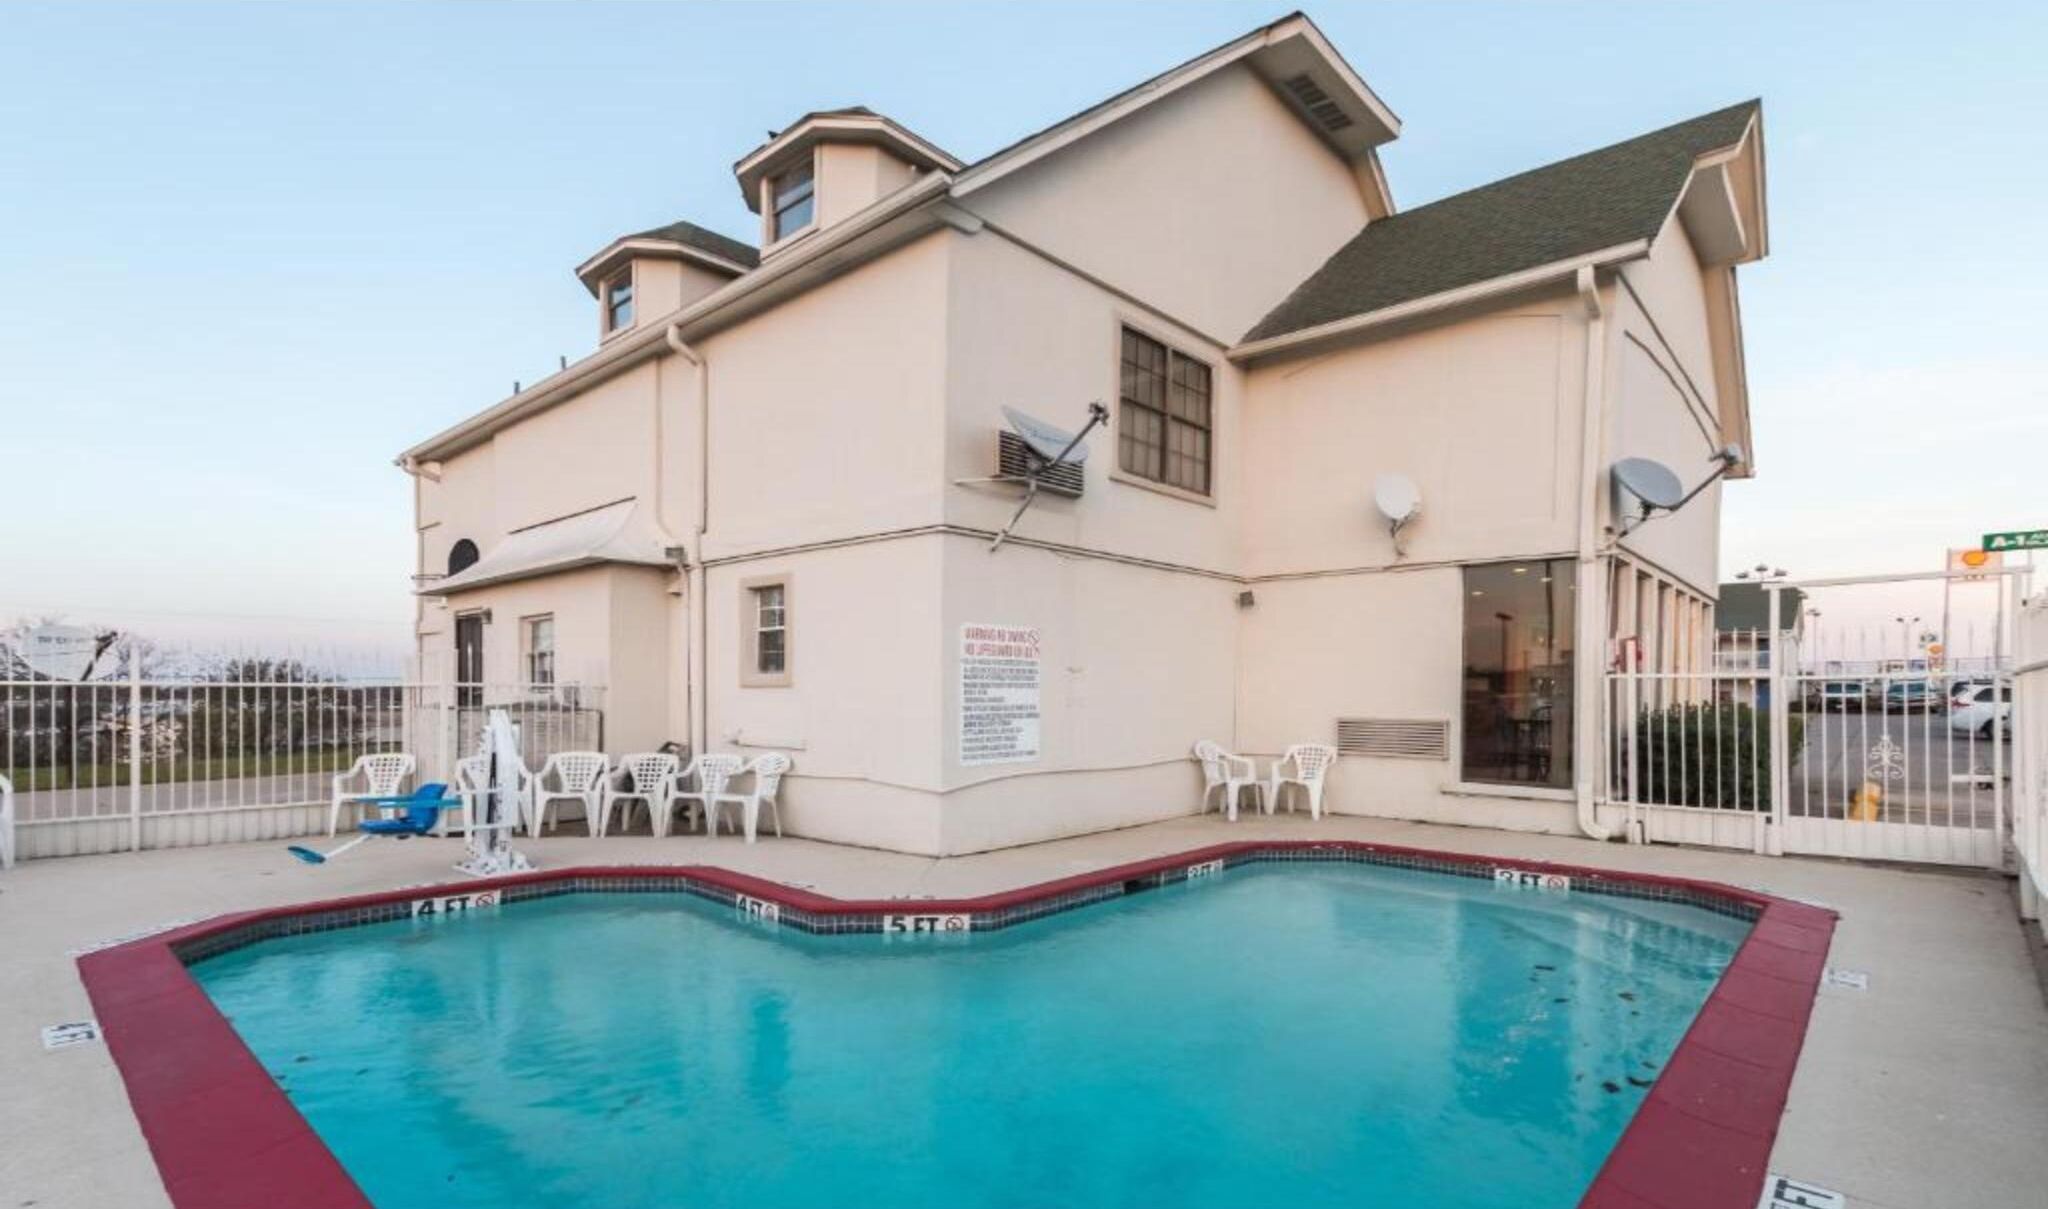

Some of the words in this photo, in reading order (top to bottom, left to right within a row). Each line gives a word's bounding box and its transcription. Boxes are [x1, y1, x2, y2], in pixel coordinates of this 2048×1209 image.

[418, 900, 434, 915] 4
[445, 896, 470, 913] FT
[892, 915, 906, 932] 5
[913, 917, 939, 933] FT
